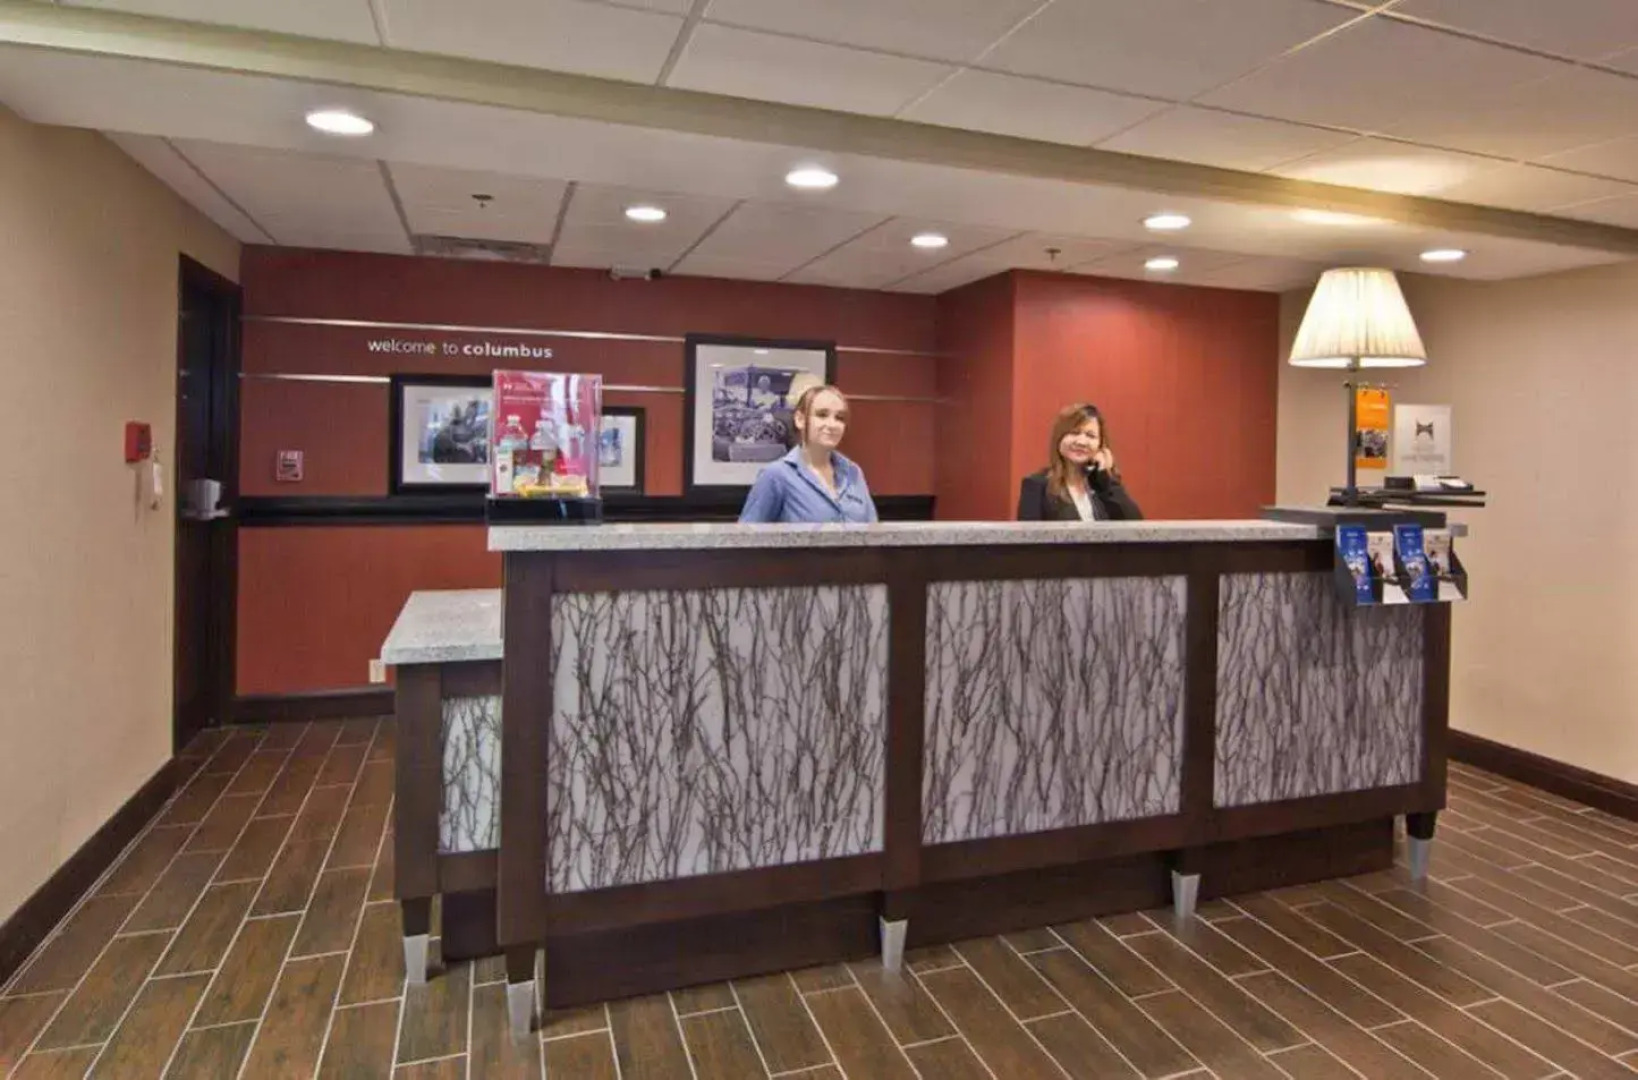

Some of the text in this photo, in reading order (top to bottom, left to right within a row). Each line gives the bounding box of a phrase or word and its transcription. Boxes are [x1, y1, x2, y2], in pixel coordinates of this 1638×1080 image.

[368, 339, 552, 359] welcome to columbus
